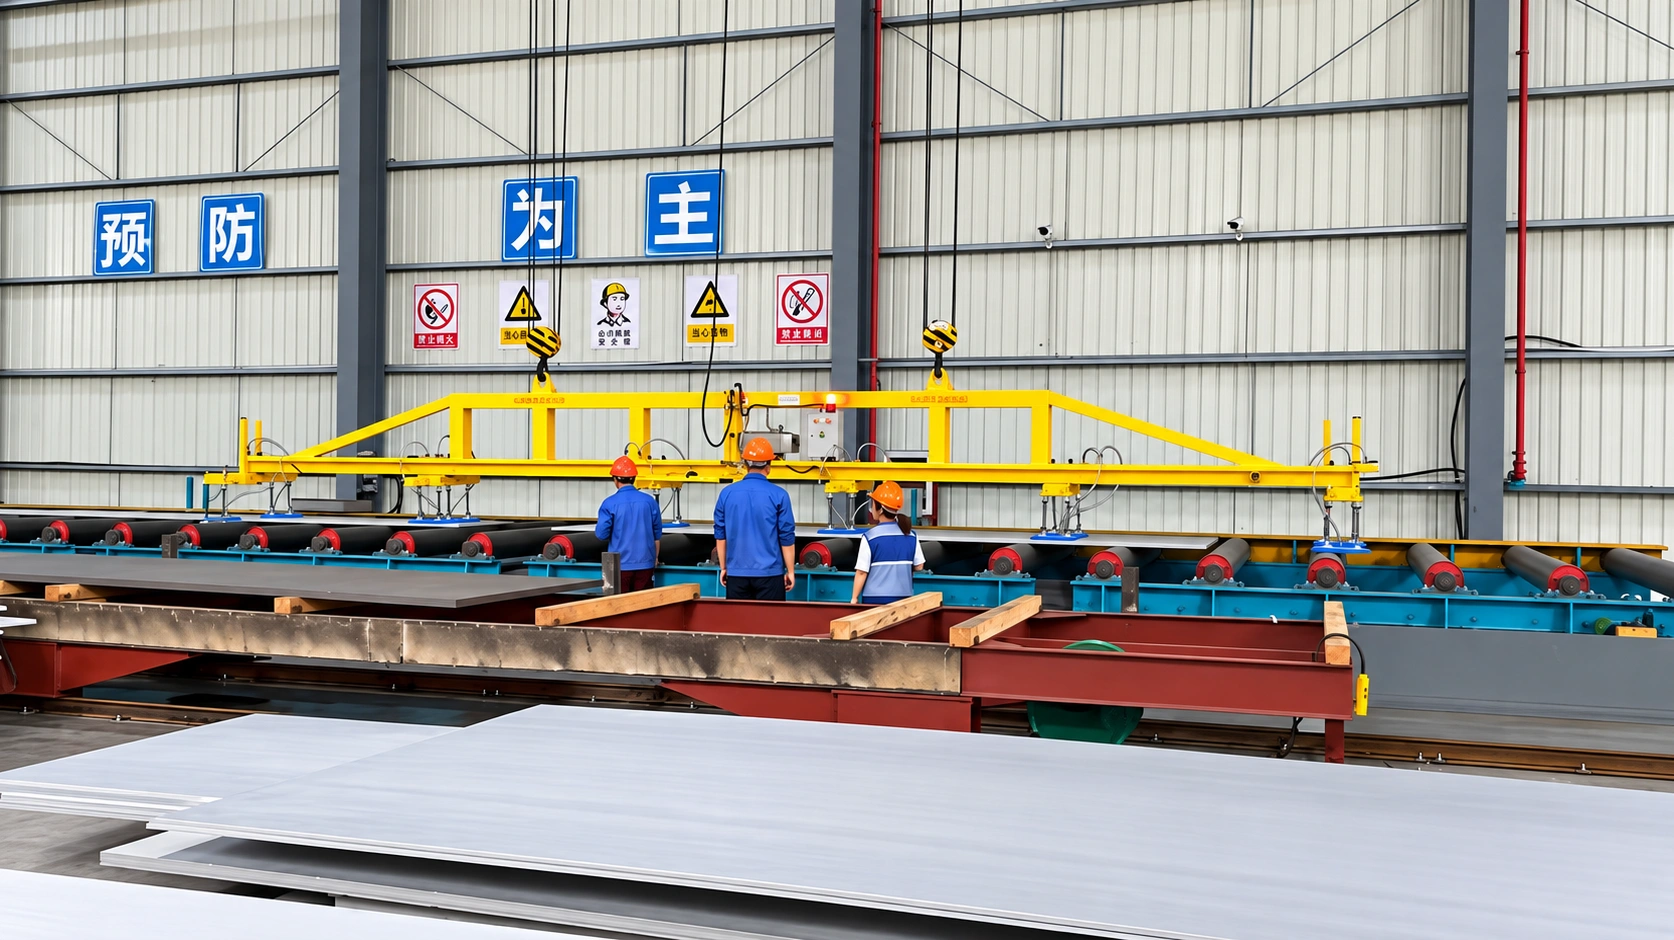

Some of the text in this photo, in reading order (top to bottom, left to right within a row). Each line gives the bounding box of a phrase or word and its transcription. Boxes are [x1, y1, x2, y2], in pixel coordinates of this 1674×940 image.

[100, 180, 714, 268] 预 防 为 主
